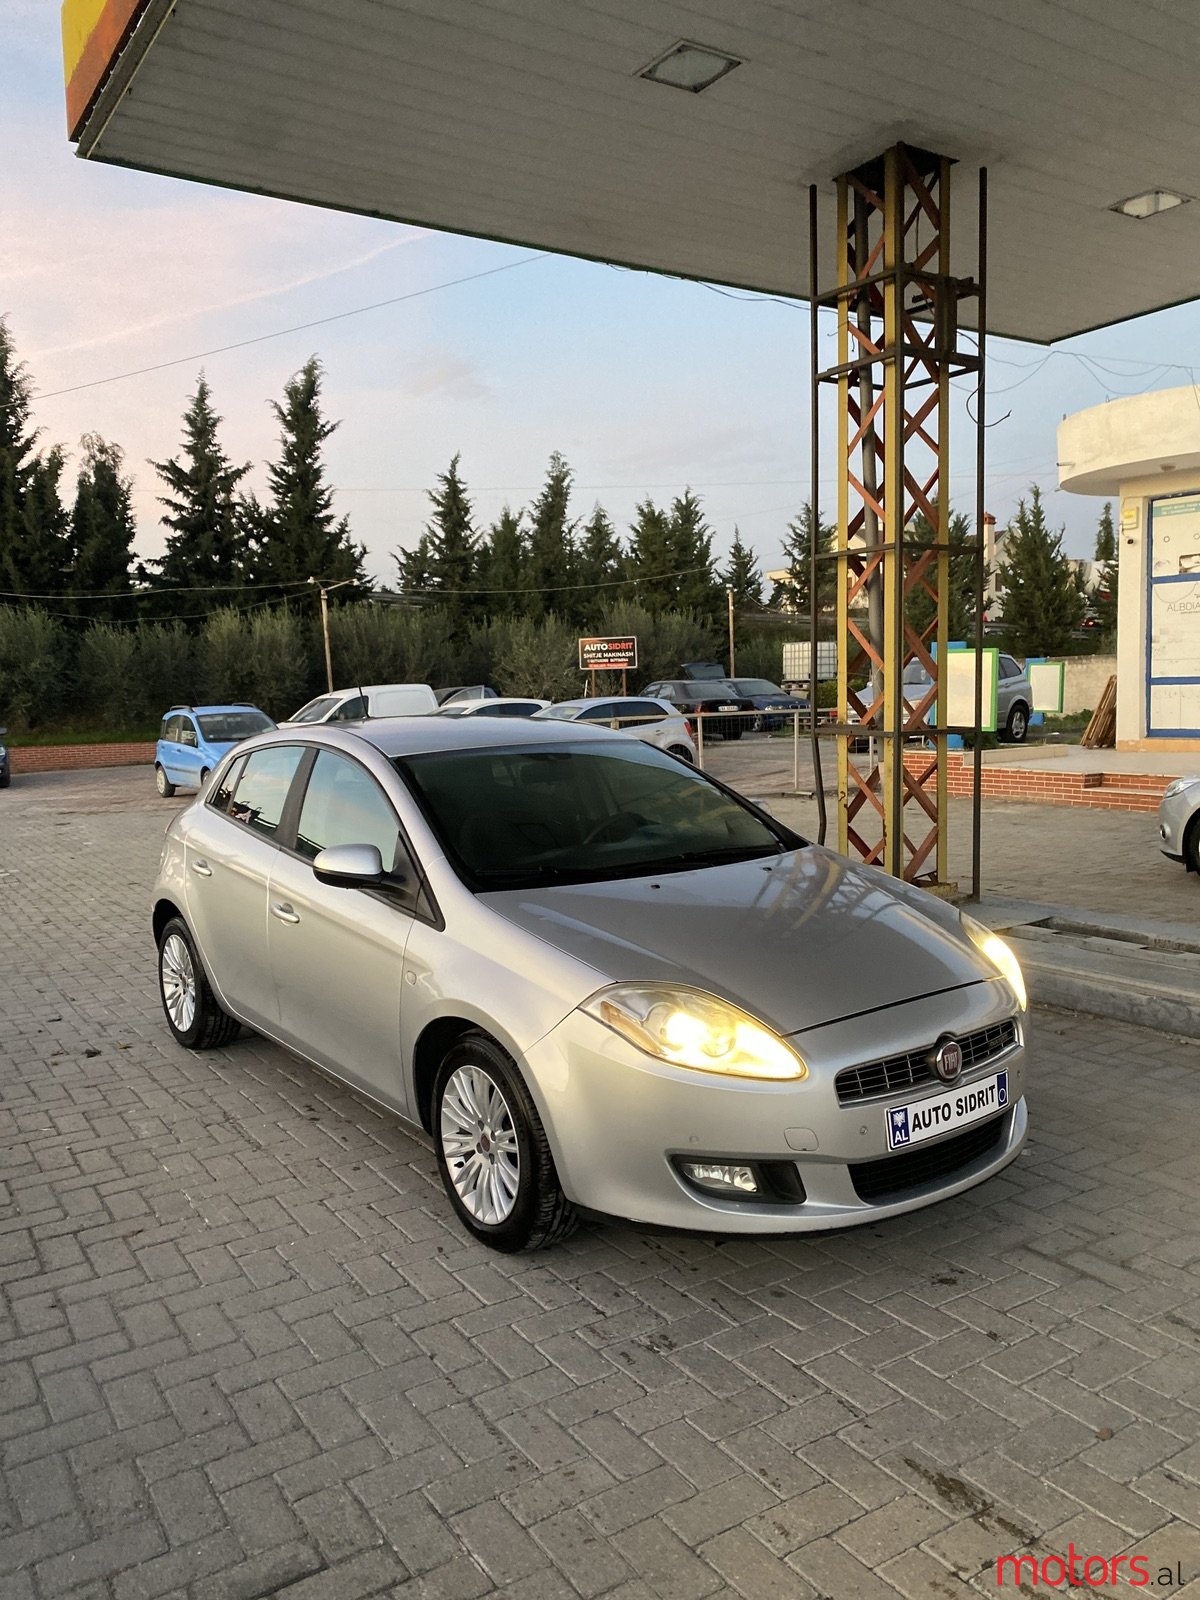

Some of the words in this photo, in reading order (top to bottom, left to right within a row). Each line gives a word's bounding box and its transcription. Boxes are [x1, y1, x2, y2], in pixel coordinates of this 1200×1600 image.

[944, 1051, 958, 1071] FIAT
[911, 1102, 952, 1133] AUTO
[955, 1084, 996, 1117] SIDRIT
[894, 1129, 909, 1144] AL
